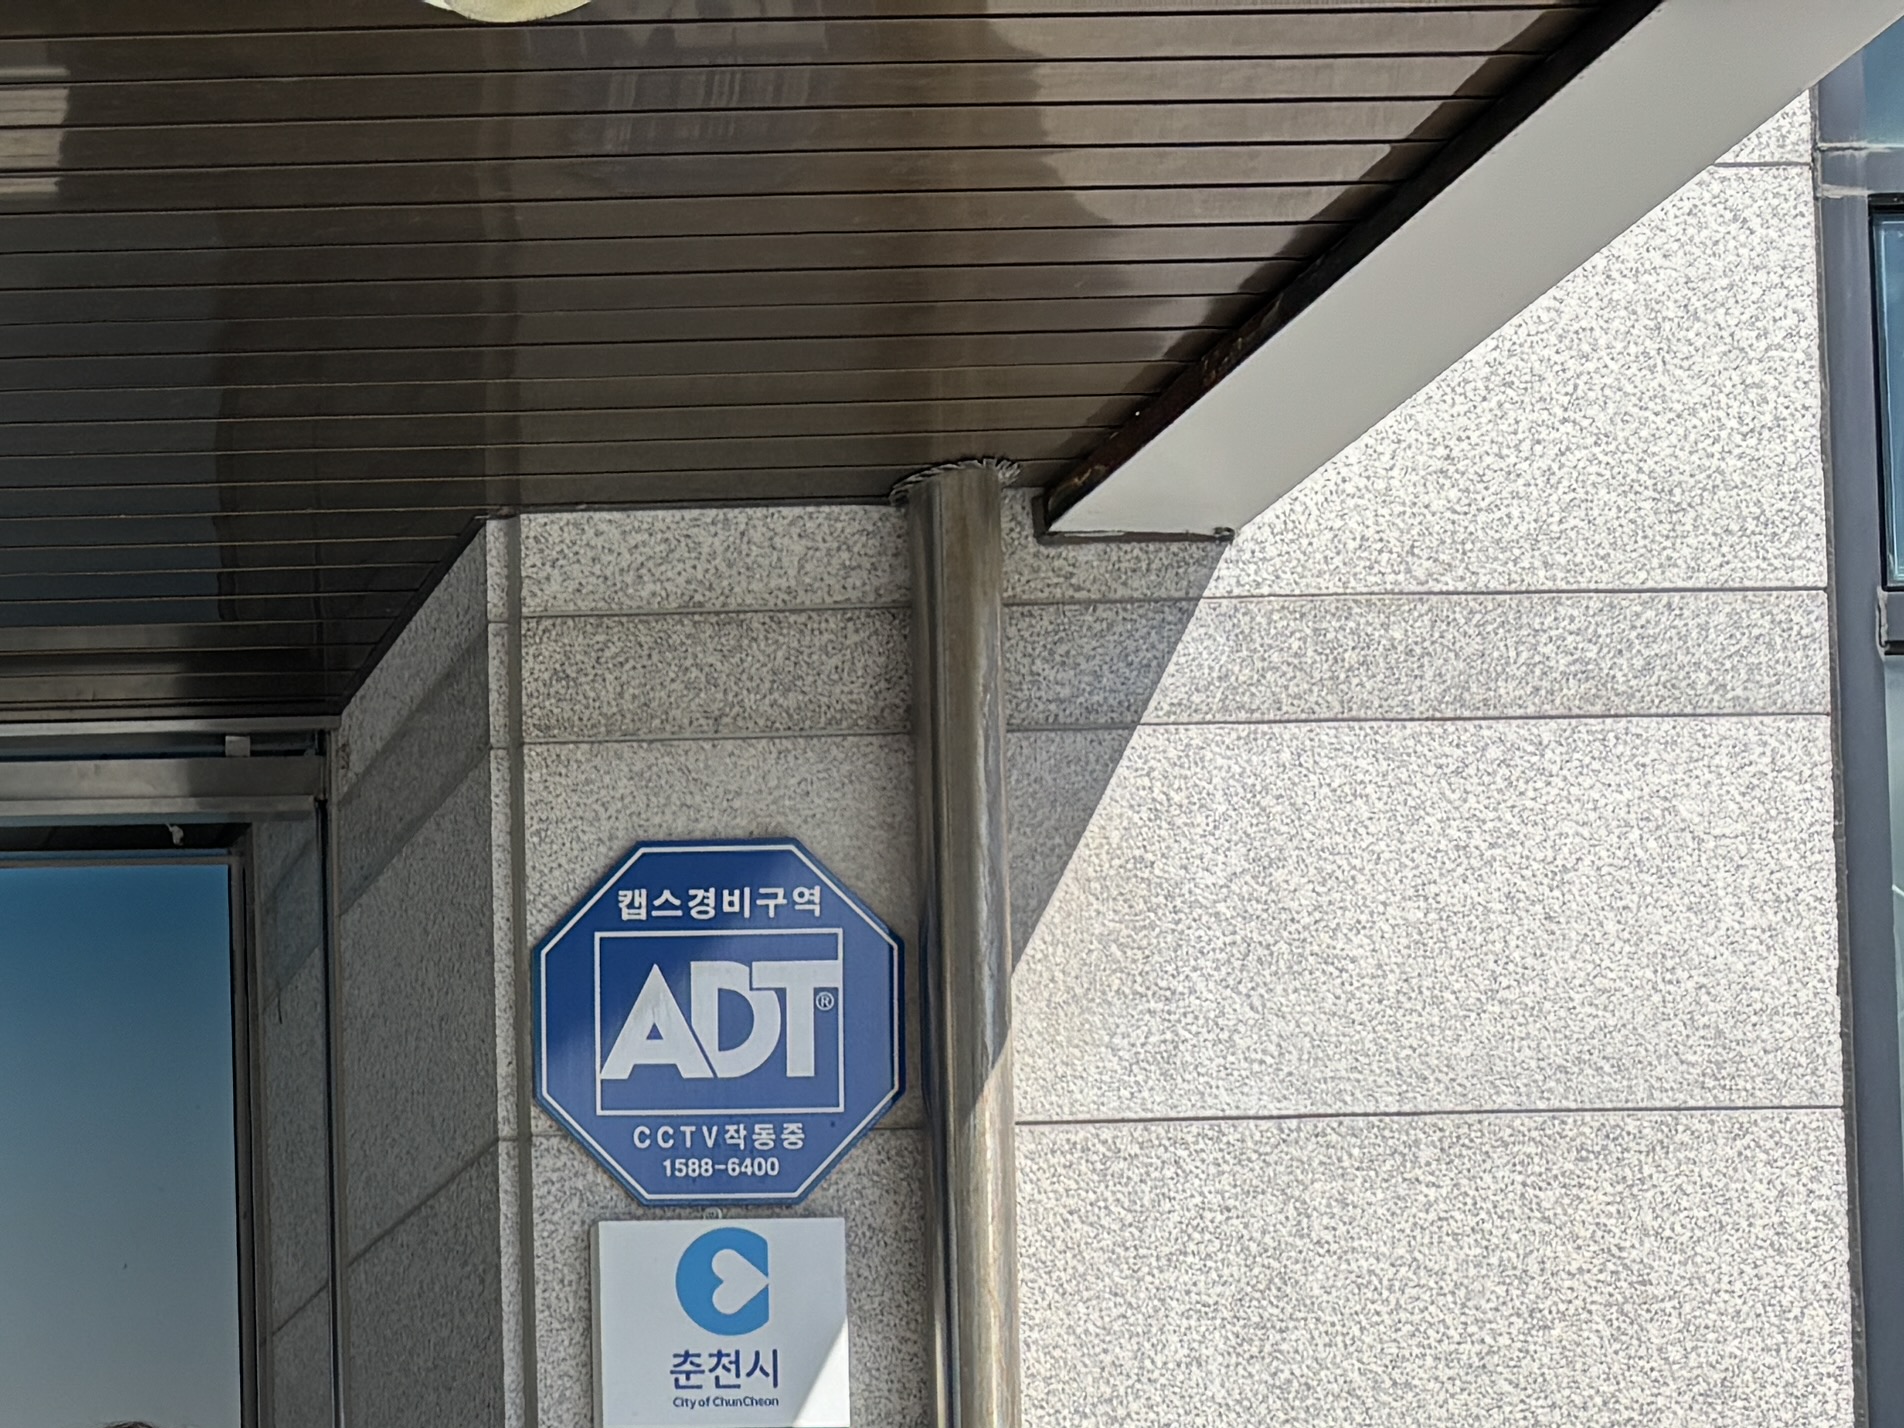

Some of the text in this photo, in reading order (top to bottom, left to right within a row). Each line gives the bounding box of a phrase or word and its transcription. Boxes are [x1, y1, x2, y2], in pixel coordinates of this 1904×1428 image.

[617, 886, 822, 920] 캡스경비구역
[600, 960, 842, 1079] ADT
[633, 1124, 806, 1151] CCTV작동중
[662, 1157, 780, 1177] 1588-6400
[670, 1349, 778, 1389] 춘천시
[673, 1396, 779, 1409] City of ChunCheon
